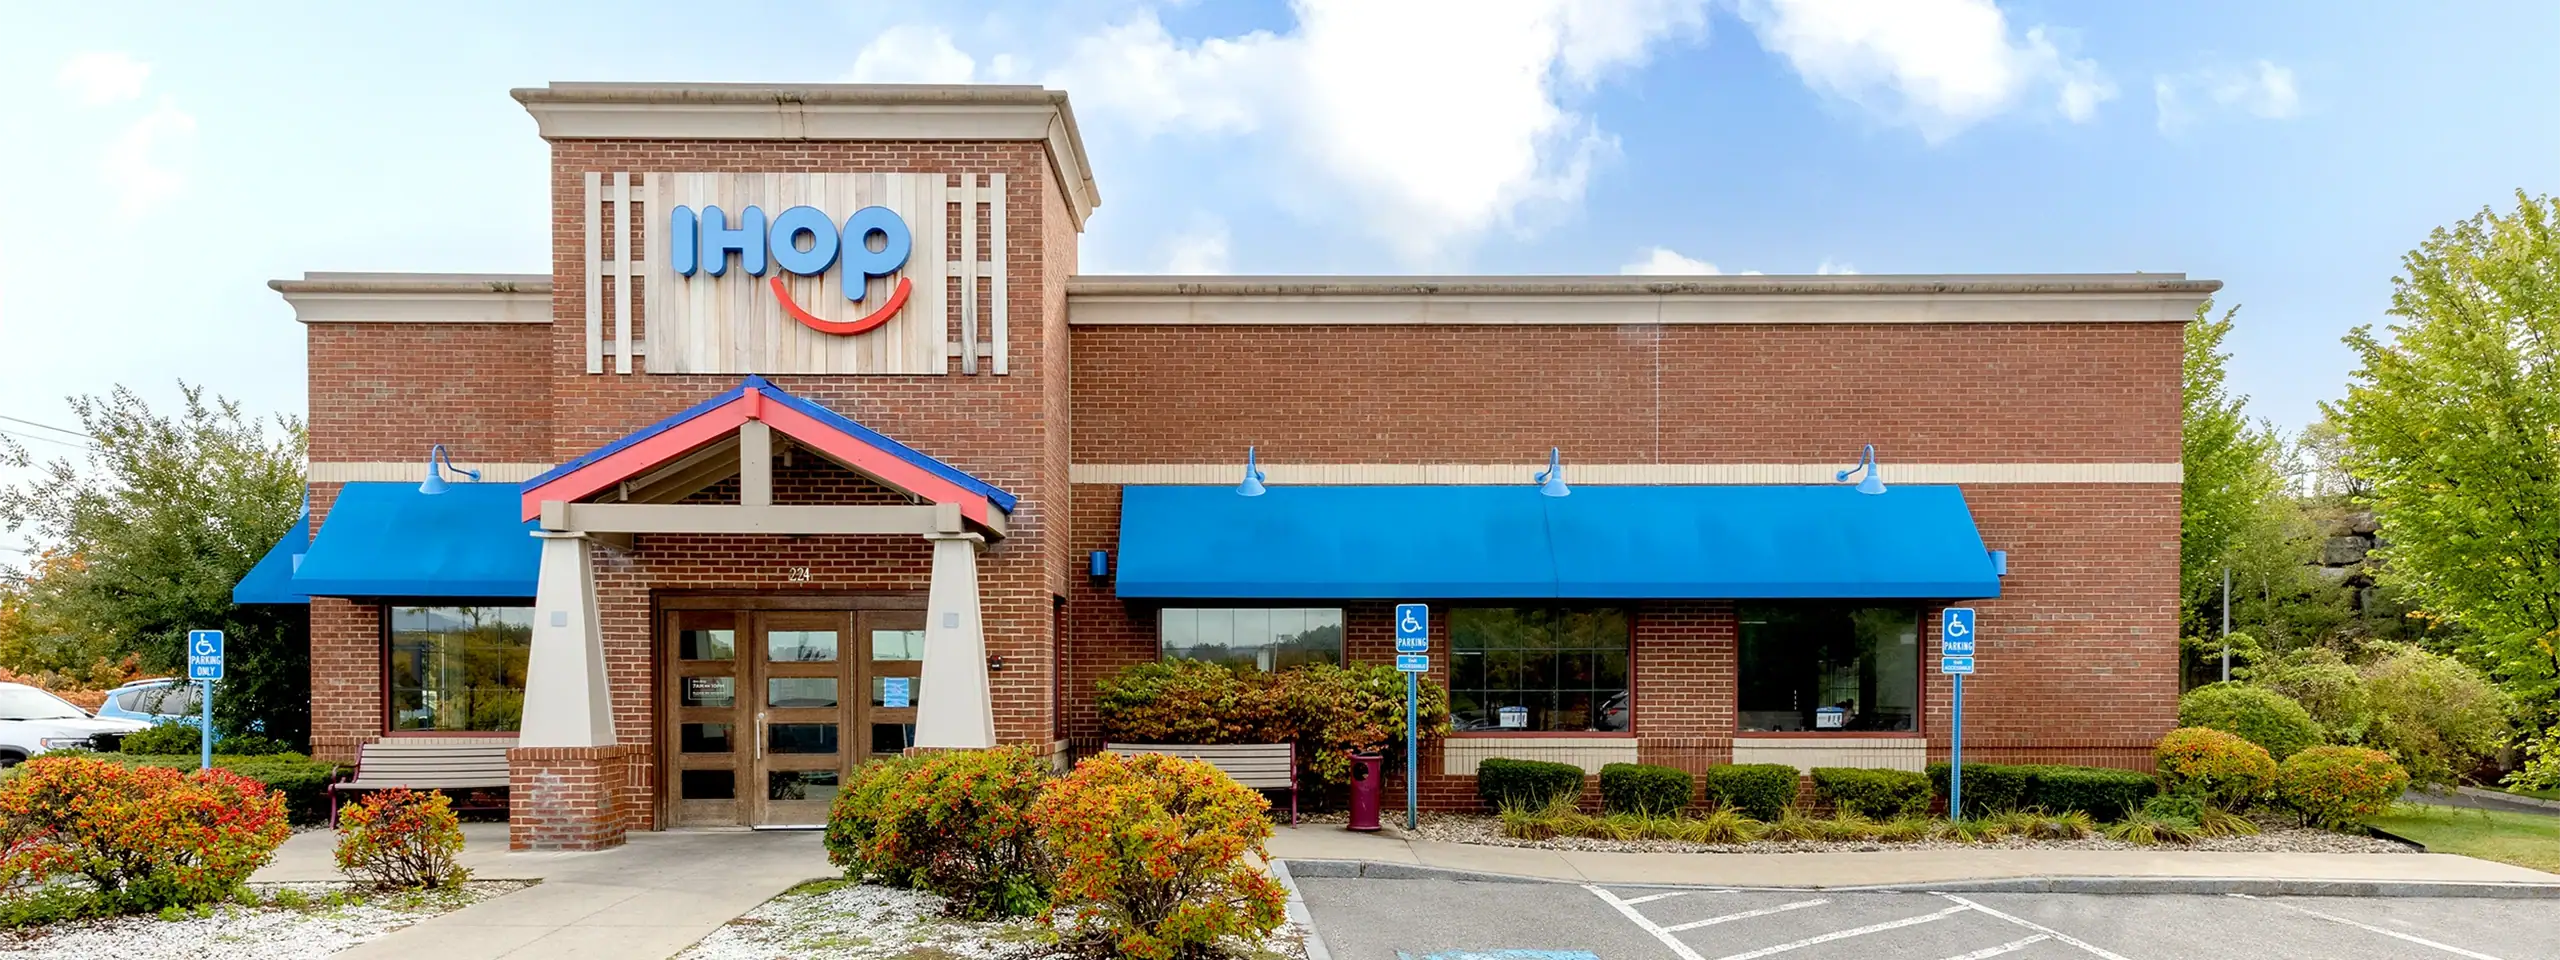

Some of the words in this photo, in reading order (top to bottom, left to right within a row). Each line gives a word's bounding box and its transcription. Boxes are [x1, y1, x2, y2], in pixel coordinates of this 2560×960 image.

[671, 204, 912, 302] IHOP
[790, 567, 810, 582] 224
[1398, 637, 1427, 647] PARKING
[1944, 641, 1973, 651] PARKING
[191, 655, 221, 665] PARKING
[197, 666, 215, 676] ONLY
